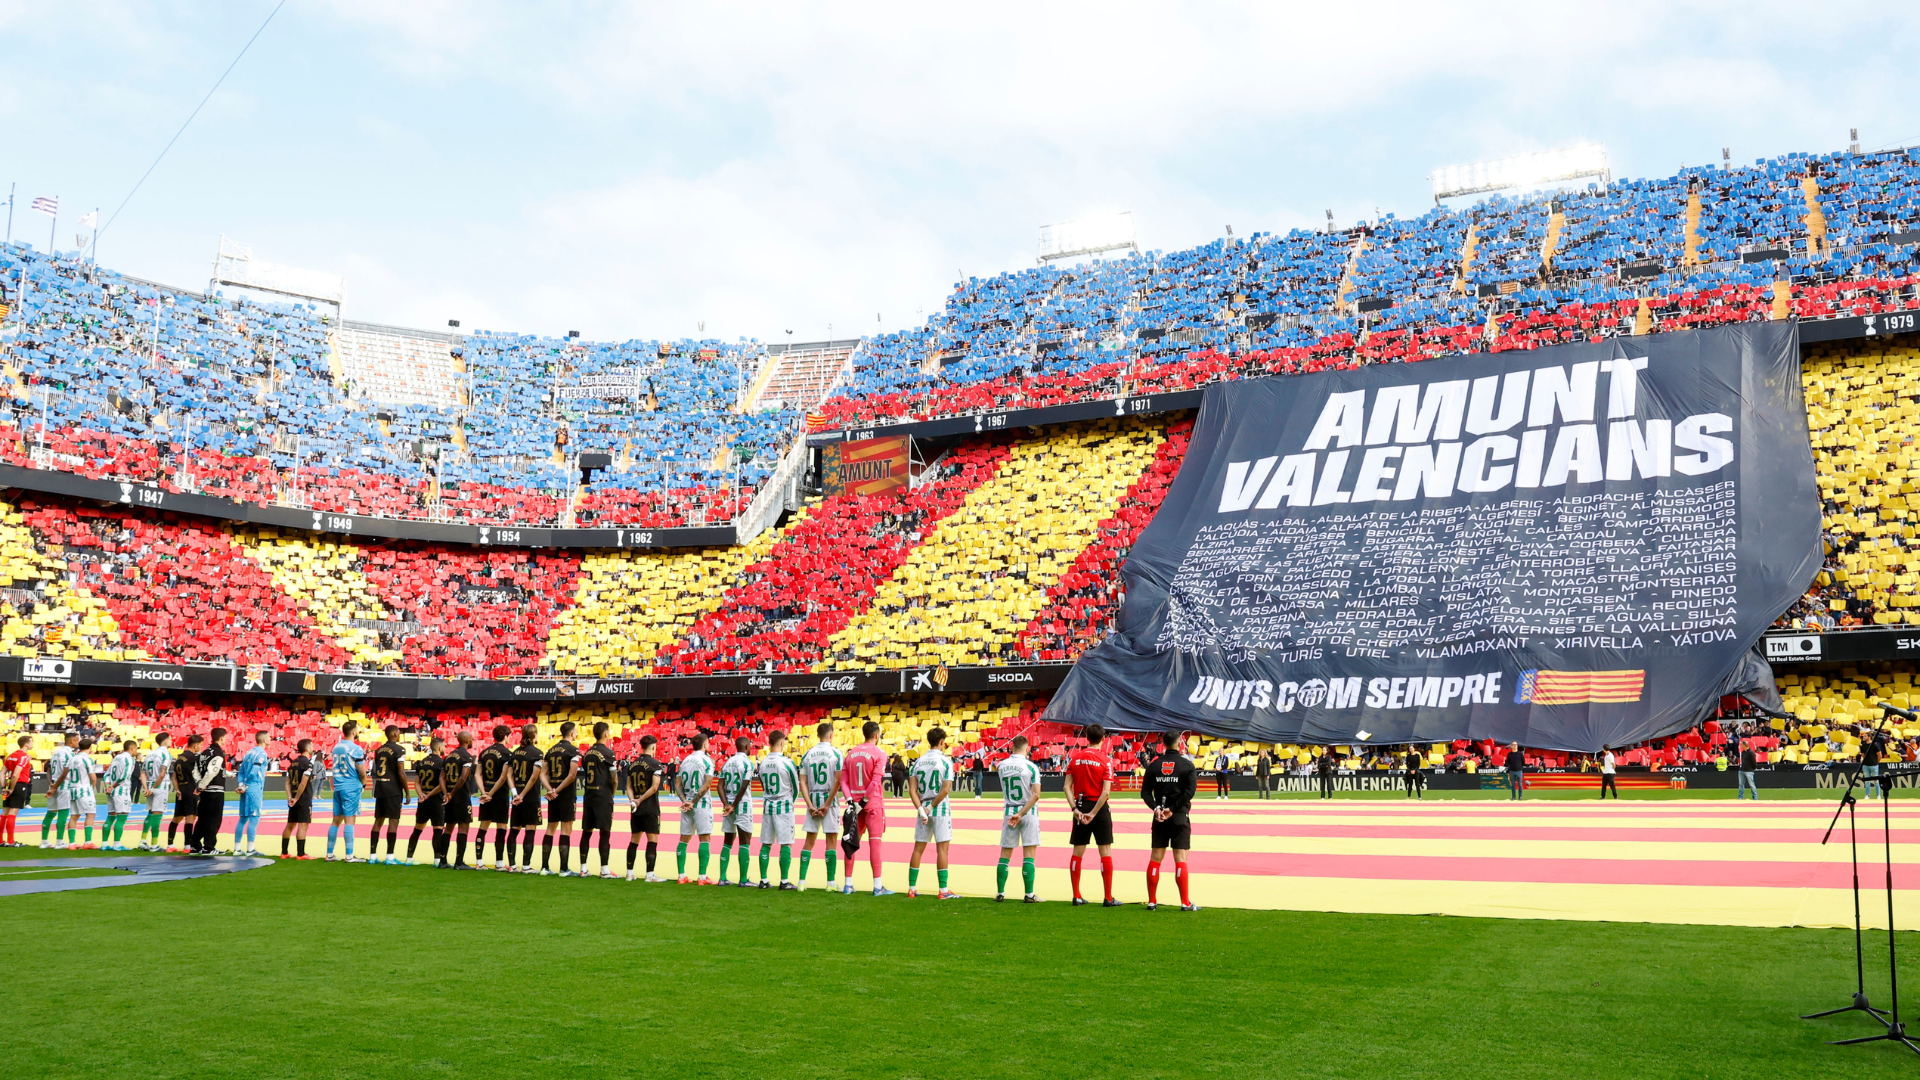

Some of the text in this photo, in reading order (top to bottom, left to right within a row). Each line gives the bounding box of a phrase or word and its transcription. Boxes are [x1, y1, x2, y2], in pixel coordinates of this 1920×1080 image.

[1883, 314, 1914, 330] 1979
[559, 388, 590, 398] FUERZA
[1302, 356, 1648, 451] AMUNT
[1130, 398, 1150, 411] 1971
[987, 414, 1006, 427] 1967
[856, 430, 874, 440] 1963
[838, 458, 892, 483] AMUNT
[1217, 412, 1734, 513] VALENCIANS
[139, 489, 164, 504] 1947
[1199, 519, 1258, 533] ALAQUÀS
[1266, 518, 1308, 528] ALBAL
[1317, 512, 1377, 524] ALBALAT
[1401, 510, 1417, 519] LA
[1421, 505, 1472, 517] RIBERA
[1481, 500, 1544, 512] ALBERIC
[1553, 492, 1644, 506] ALBORACHE
[1654, 481, 1735, 497] ALCÀSSER
[328, 516, 352, 530] 1949
[1190, 500, 1736, 550] ALZIRA BENETÚSSER BENICULL DE XÚQUER BENIFAIÓ BENIMODO
[1195, 490, 1735, 542] L'ALCÚDIA ALDAIA ALFAFAR ALFARB ALGEMESÍ ALGINET ALMUSSAFES
[496, 530, 520, 542] 1954
[630, 532, 652, 544] 1962
[1182, 518, 1736, 566] CARCAIXENT CARLET CASTELLAR-OLIVERAL CATADAU CATARROJA
[1186, 508, 1736, 558] BENIPARRELL BÉTERA BUGARRA BUÑOL CALLES CAMPORROBLES
[1206, 566, 1250, 578] AGUAS
[1287, 560, 1344, 574] PALMAR
[1383, 556, 1480, 566] PERELLONET
[1495, 554, 1512, 562] EL
[1519, 550, 1569, 558] SALER
[1658, 536, 1736, 552] FAITANAR
[1296, 528, 1736, 566] FUENTES CHERA CHESTE CHIVA CORBERA CULLERA
[1237, 544, 1736, 584] FORN D'ALCEDO FORTALENY FUENTERROBLES GESTALGAR
[1254, 552, 1736, 592] GUADASSUAR LA POBLA LLARGA LA TORRE LLAURÍ LLÍRIA
[1230, 574, 1736, 616] MASSANASSA MILLARES MISLATA MONTROI MONTSERRAT
[1231, 562, 1736, 606] DE LA CORONA LLOMBAI LORIGUILLA MACASTRE MANISES
[1243, 585, 1736, 625] PATERNA PEDRALBA PICANYA PICASSENT PINEDO
[1386, 615, 1446, 628] POBLET
[1460, 606, 1577, 620] RAFELGUARAF
[1592, 604, 1636, 613] REAL
[1652, 596, 1737, 610] REQUENA
[1296, 616, 1736, 648] SOT DE CHERA SUECA TAVERNES DE LA VALLDIGNA
[1312, 606, 1737, 638] RIOLA SEDAVÍ SENYERA SIETE AGUAS SILLA
[1280, 628, 1737, 663] TURÍS UTIEL VILAMARXANT XIRIVELLA YÁTOVA
[1770, 642, 1788, 652] TM
[28, 663, 44, 673] TM
[132, 670, 182, 682] SKODA
[988, 672, 1034, 683] SKODA
[332, 678, 371, 694] Coca-Cola
[598, 683, 634, 694] AMSTEL
[748, 676, 772, 686] divina
[820, 676, 857, 691] Coca-Cola
[1188, 675, 1273, 710] UNITS
[1365, 671, 1502, 709] SEMPRE
[176, 764, 184, 780] 9
[377, 756, 387, 776] 3
[485, 759, 494, 780] 8
[550, 756, 562, 778] 15
[587, 762, 595, 784] 5
[810, 762, 828, 785] 16
[856, 762, 864, 787] 1
[420, 770, 435, 789] 22
[631, 772, 646, 794] 16
[682, 770, 700, 792] 24
[724, 772, 740, 795] 23
[762, 772, 780, 795] 19
[917, 770, 940, 794] 34
[1002, 776, 1023, 800] 15
[1277, 776, 1428, 792] AMUN VALENCIAS
